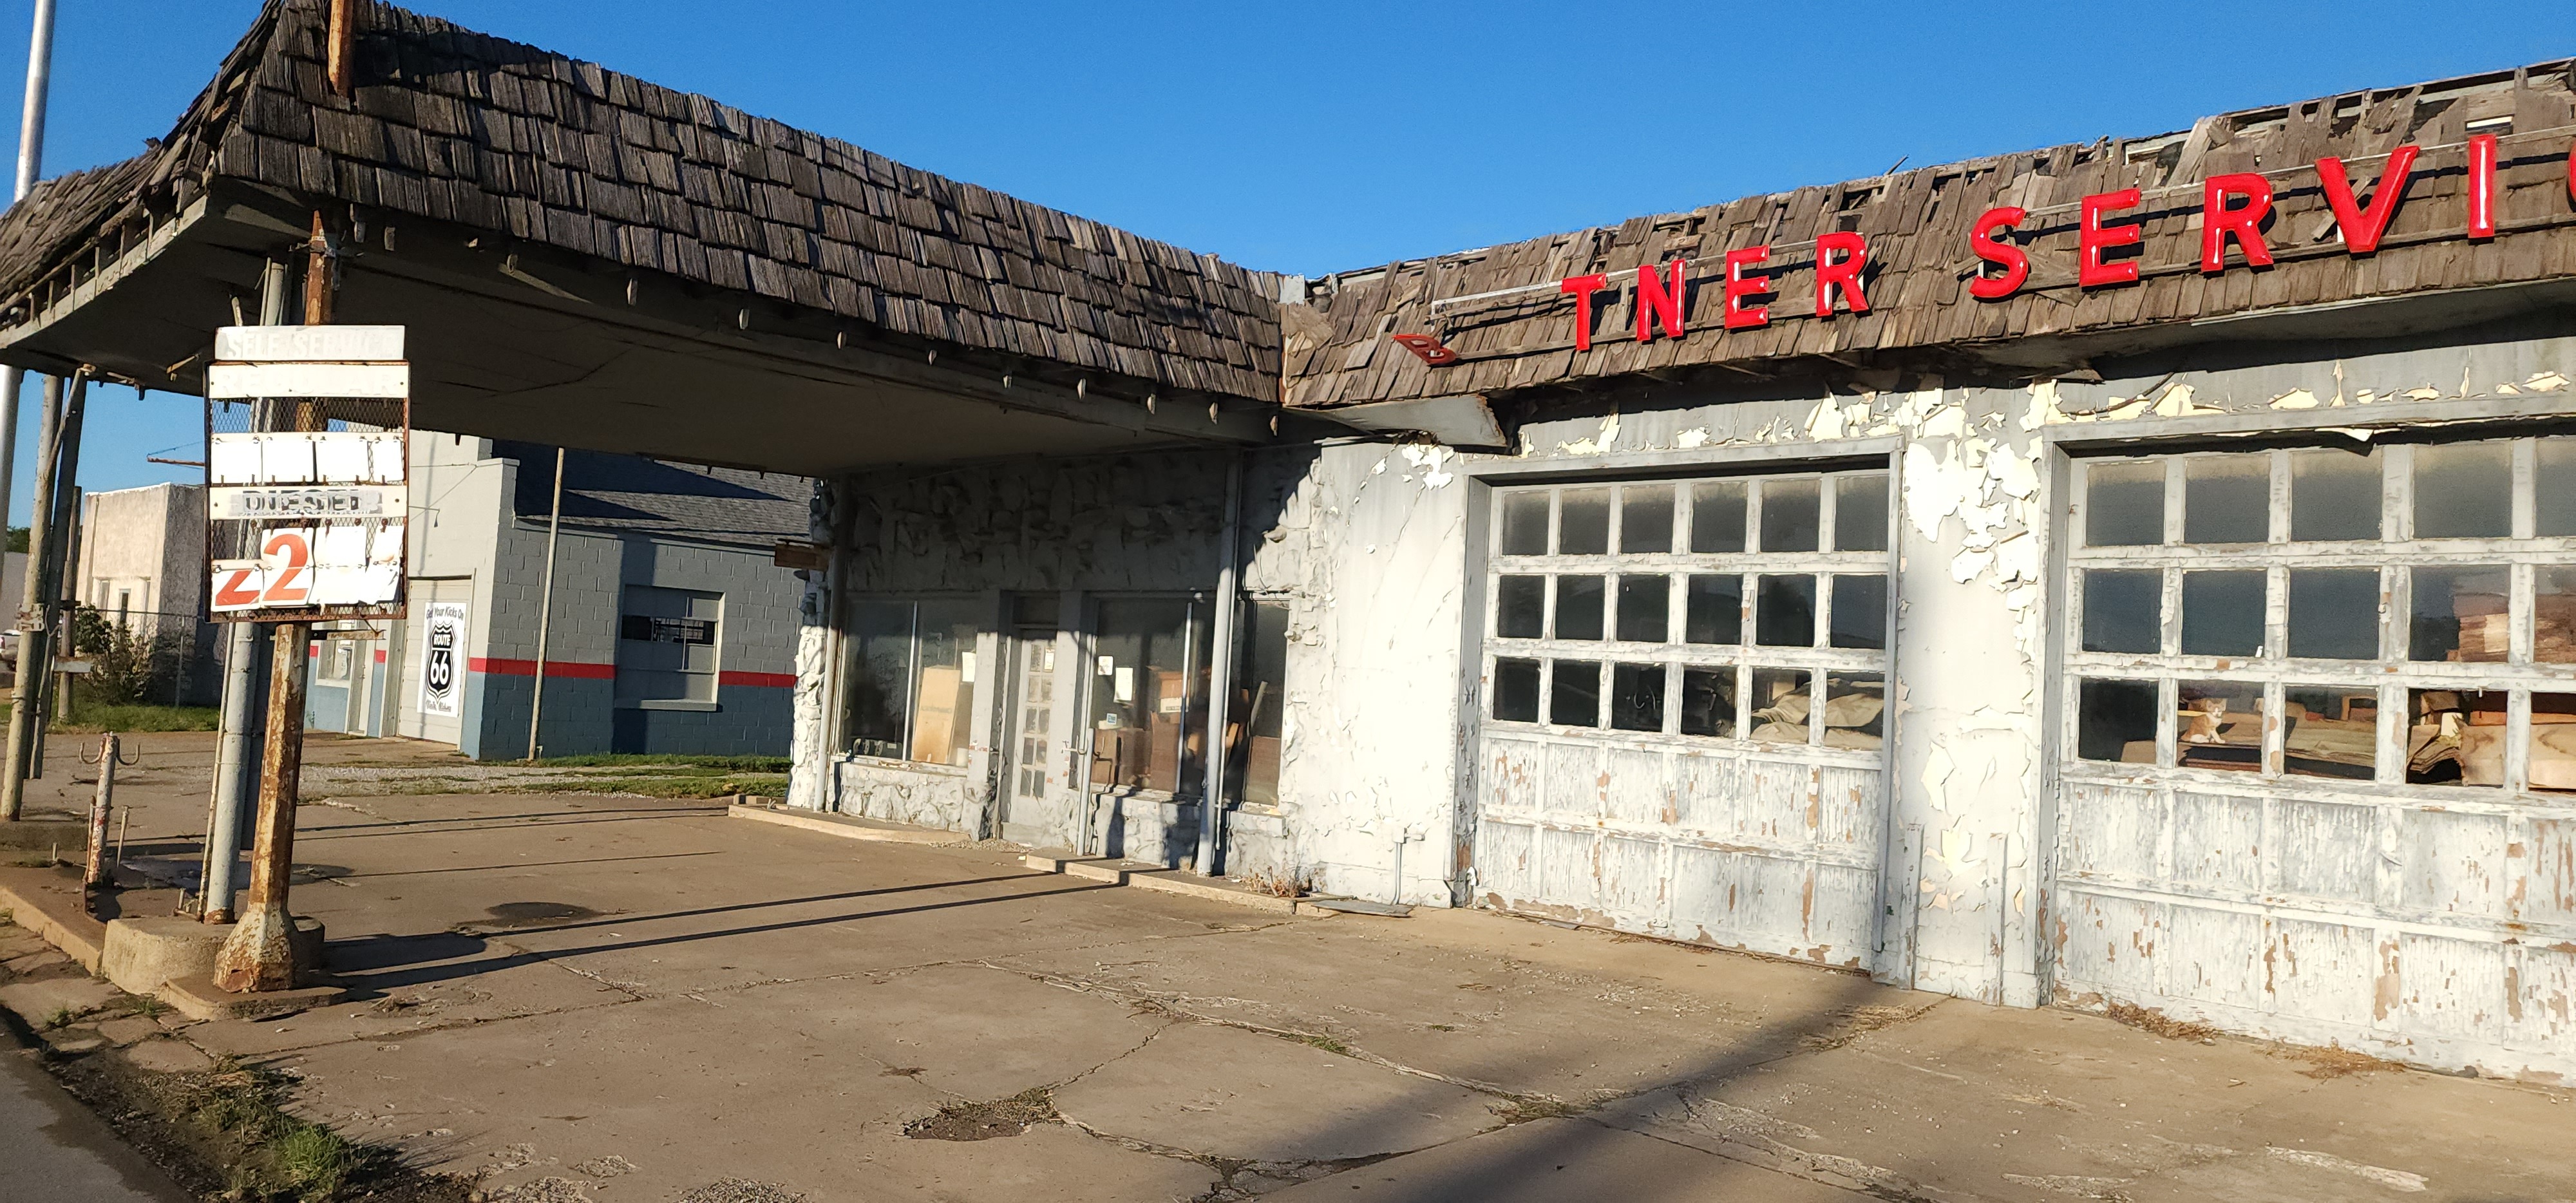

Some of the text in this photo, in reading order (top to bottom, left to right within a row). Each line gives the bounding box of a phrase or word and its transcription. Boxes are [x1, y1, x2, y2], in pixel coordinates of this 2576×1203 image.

[1561, 232, 1870, 351] TNER
[1968, 134, 2576, 298] SERVI
[434, 634, 451, 646] ROUTE
[430, 651, 449, 685] 66
